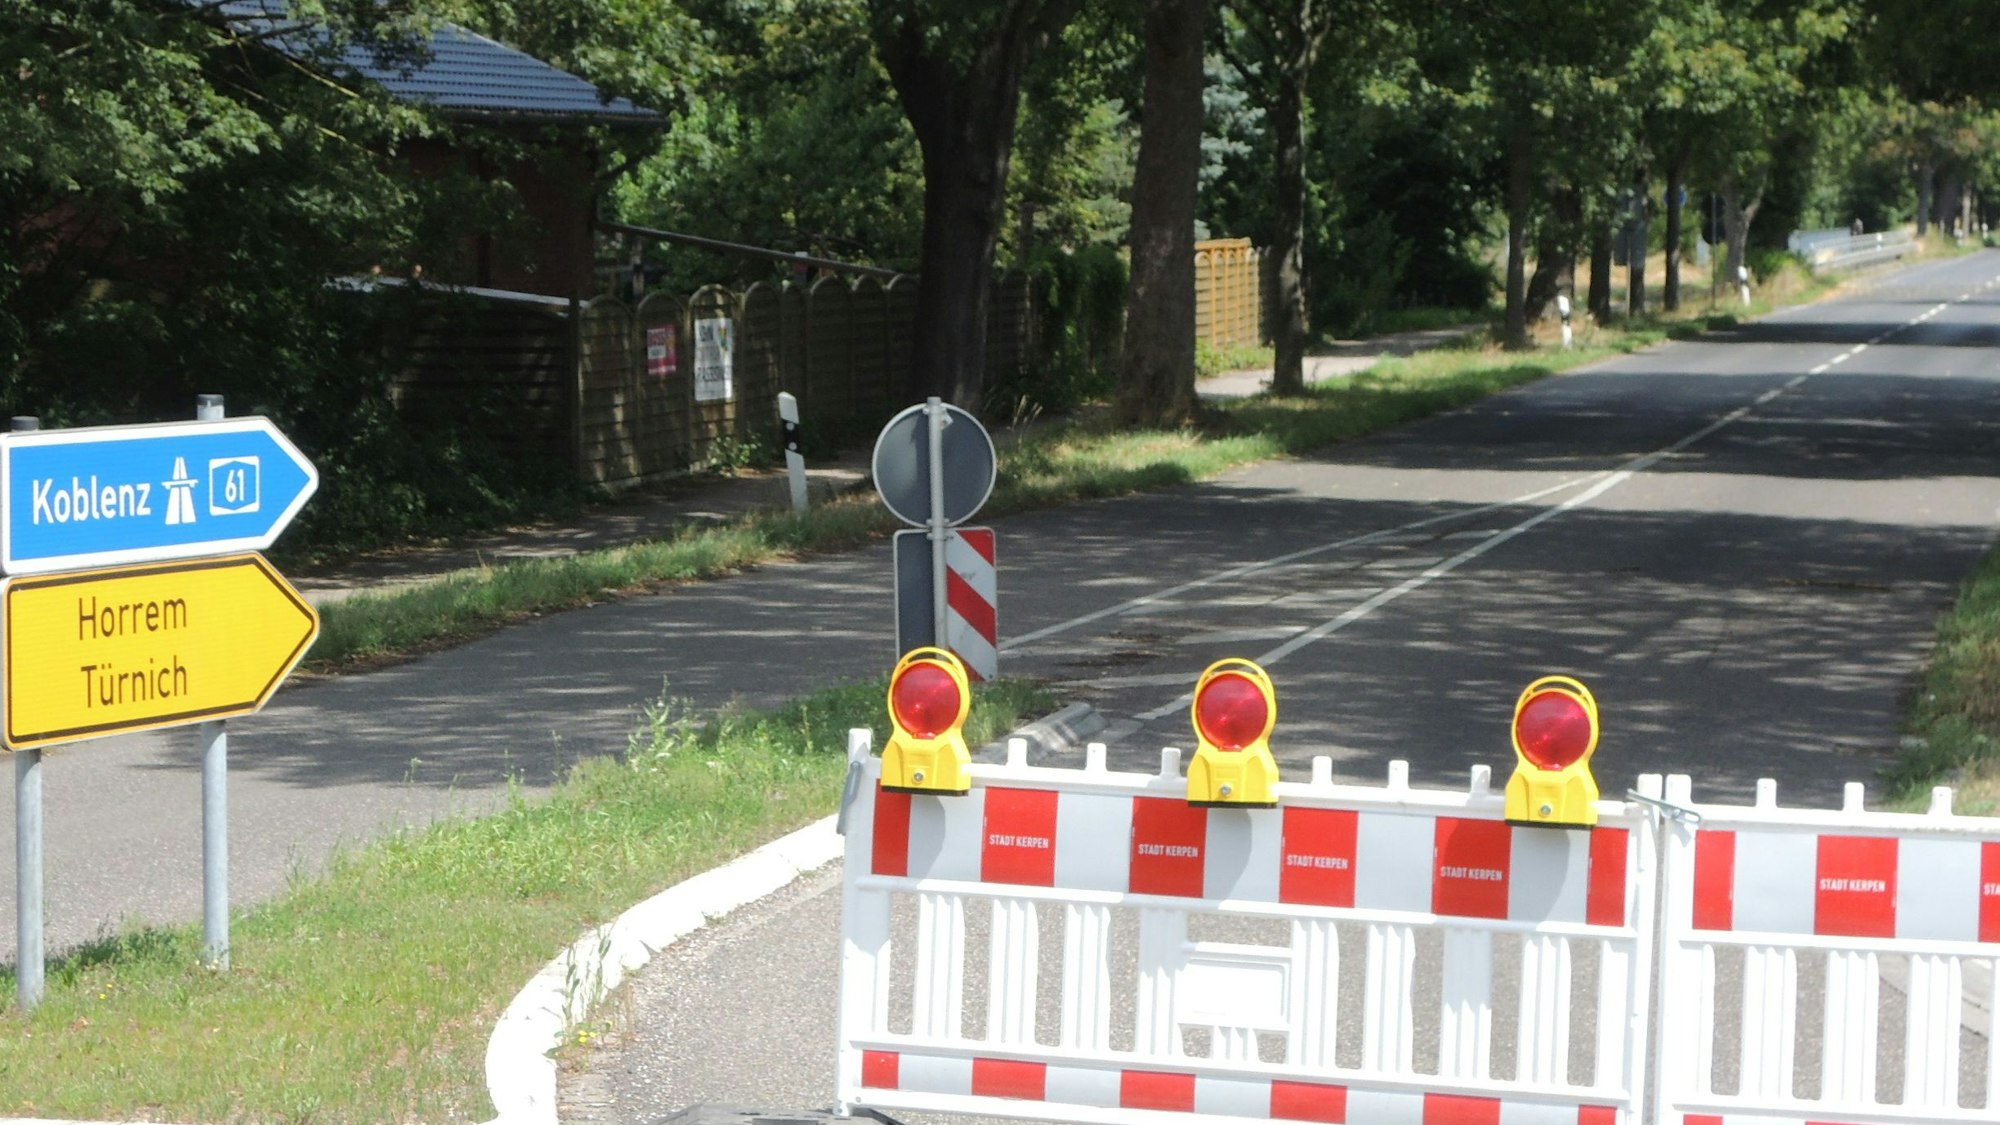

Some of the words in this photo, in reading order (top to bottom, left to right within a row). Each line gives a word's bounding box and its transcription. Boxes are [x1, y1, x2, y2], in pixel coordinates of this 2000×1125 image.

[32, 474, 152, 525] Koblenz
[225, 468, 245, 502] 61
[78, 595, 187, 641] Horrem
[81, 655, 188, 708] Türnich
[989, 834, 1015, 846] STADT
[1016, 836, 1049, 849] KERPEN
[1138, 843, 1165, 855] STADT
[1166, 845, 1198, 858] KERPEN
[1287, 854, 1313, 867] STADT
[1314, 856, 1348, 870] KERPEN
[1440, 866, 1467, 878] STADT
[1468, 868, 1503, 881] KERPEN
[1819, 878, 1848, 891] STADT
[1849, 879, 1885, 892] KERPEN
[1984, 883, 2000, 896] STA
